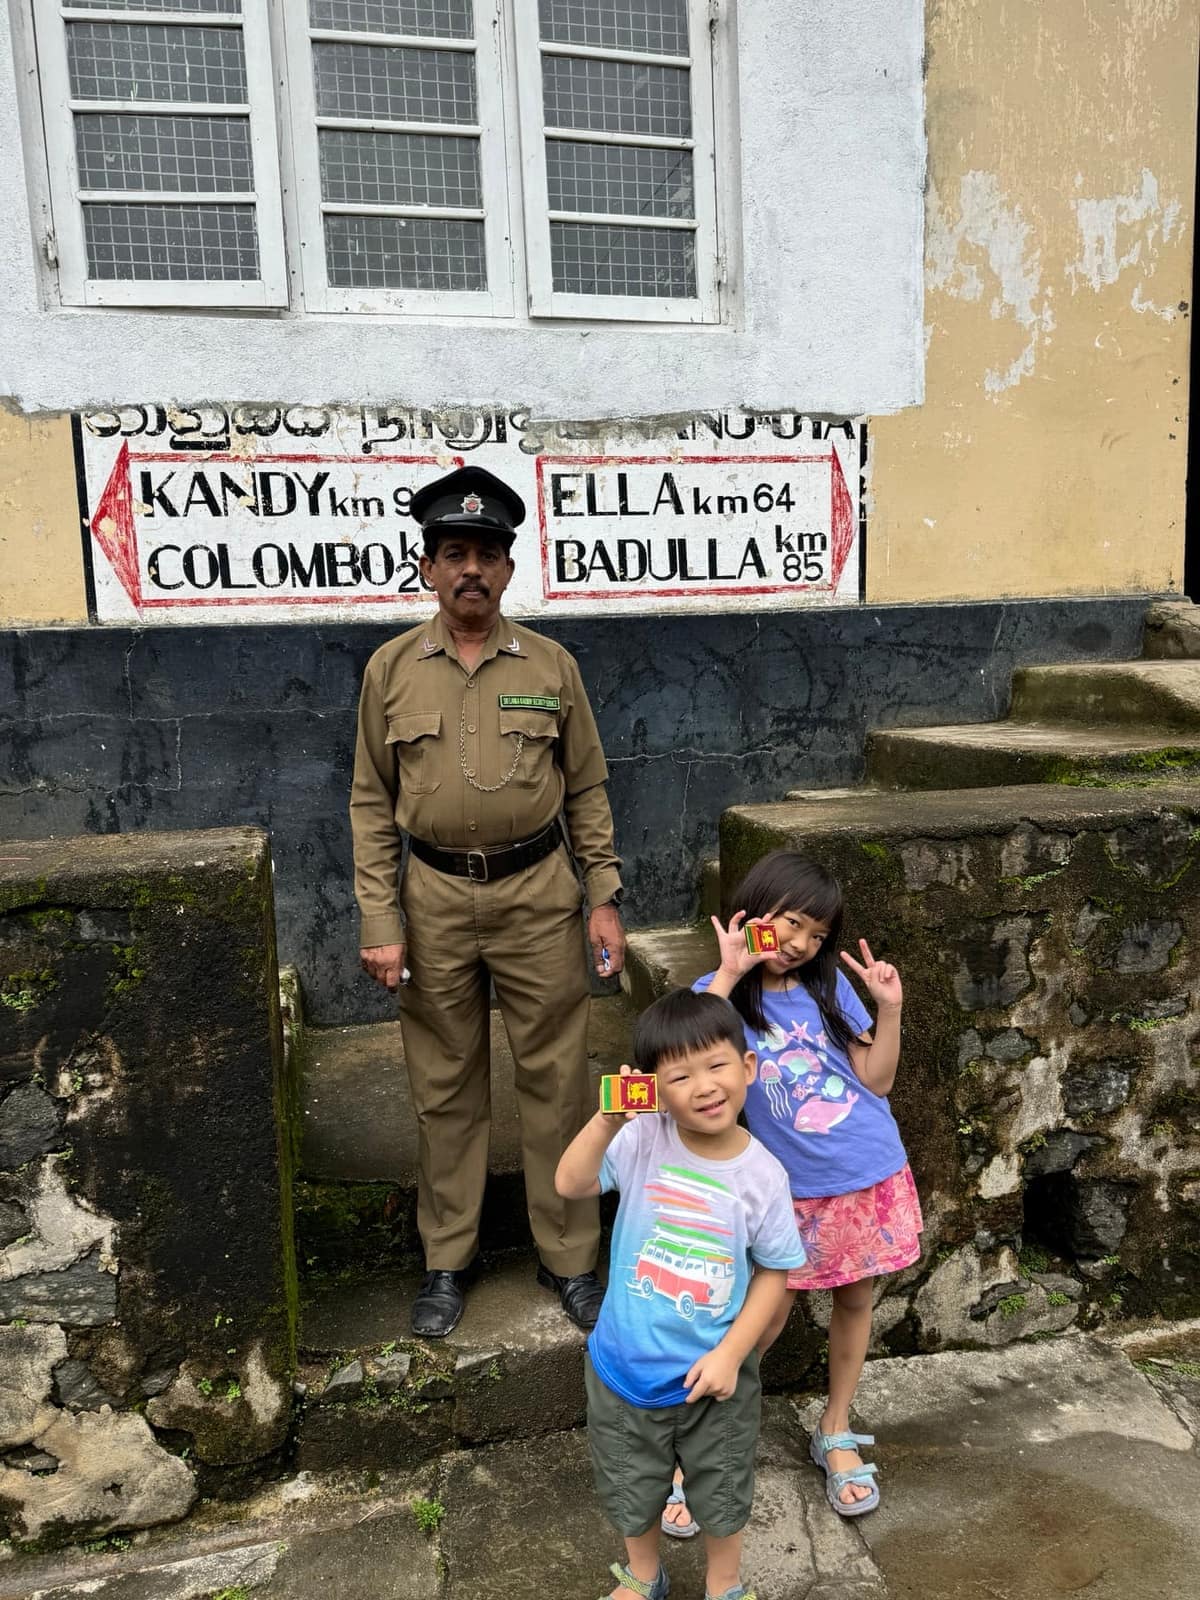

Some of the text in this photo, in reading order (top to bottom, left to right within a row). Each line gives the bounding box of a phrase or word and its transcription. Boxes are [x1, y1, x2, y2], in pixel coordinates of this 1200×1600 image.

[141, 471, 329, 517] KANDY
[329, 487, 385, 517] km
[552, 473, 796, 517] ELLA km 64
[147, 542, 395, 590] COLOMBO
[399, 530, 420, 561] k
[555, 524, 827, 583] BADULLA km 85
